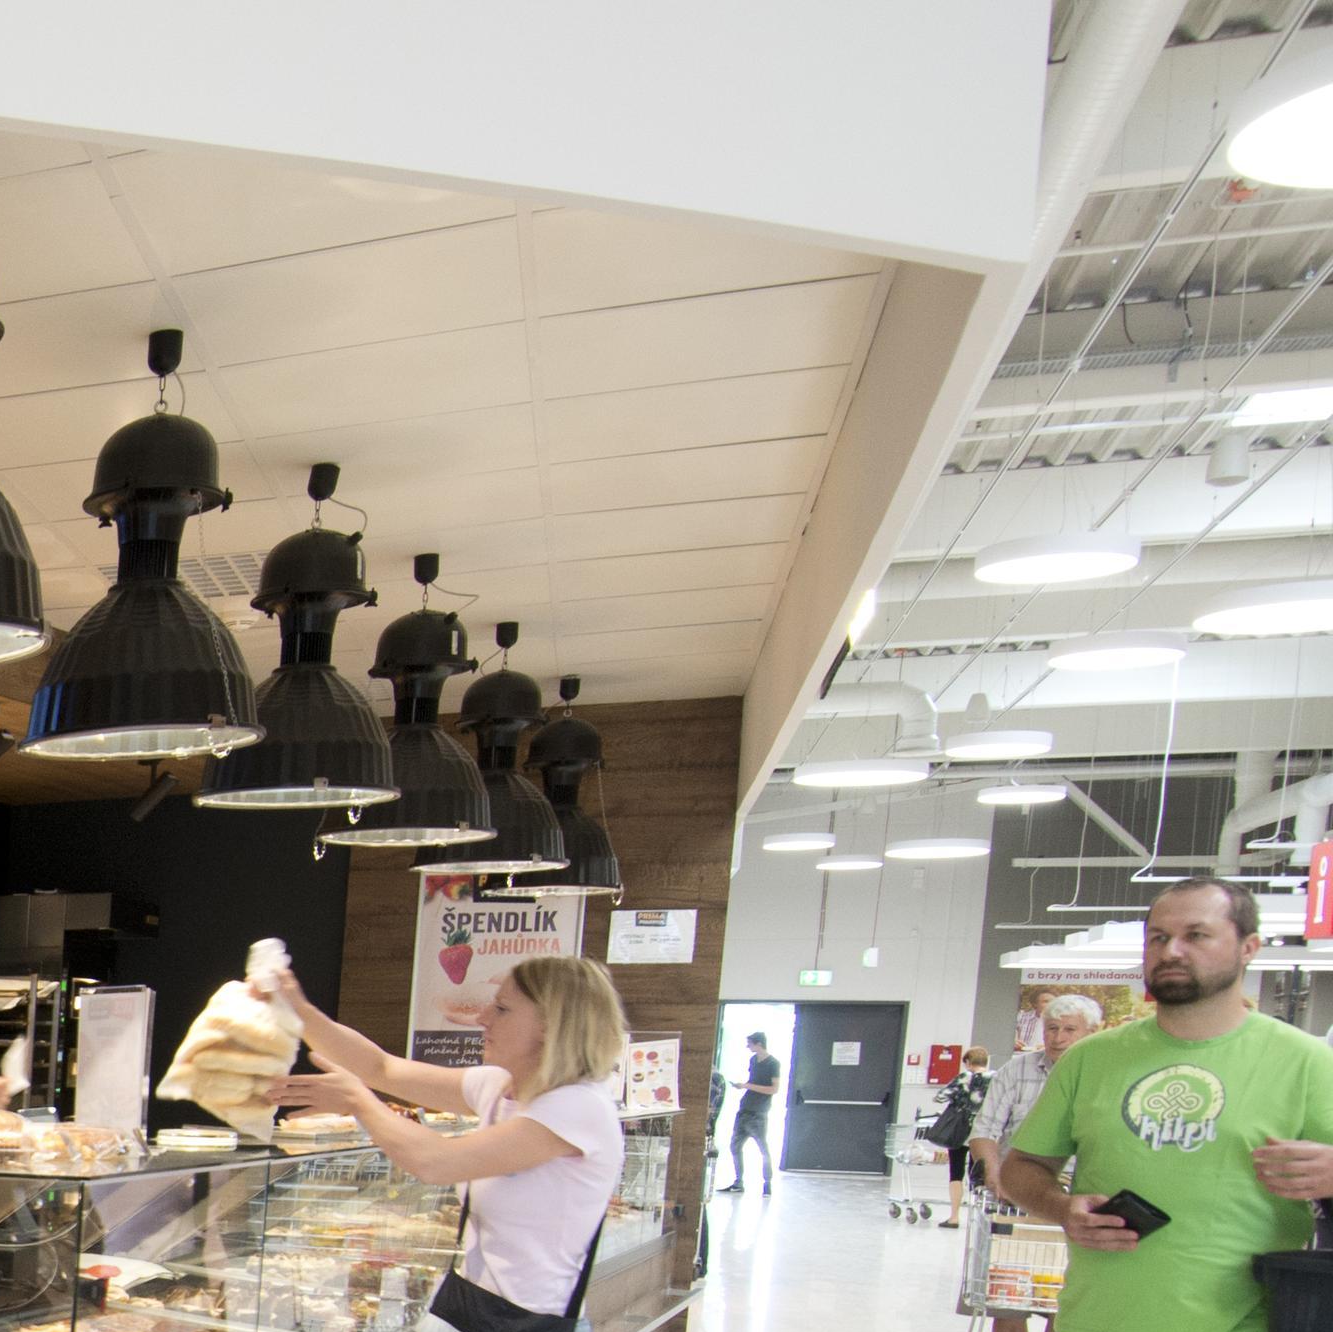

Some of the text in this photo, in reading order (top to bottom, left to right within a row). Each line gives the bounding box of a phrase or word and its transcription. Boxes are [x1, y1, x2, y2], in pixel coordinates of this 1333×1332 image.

[441, 905, 559, 934] ŠPENDLÍK
[477, 934, 561, 956] JAHŮDKA
[1038, 971, 1063, 981] brzy
[1084, 971, 1143, 980] shledanou
